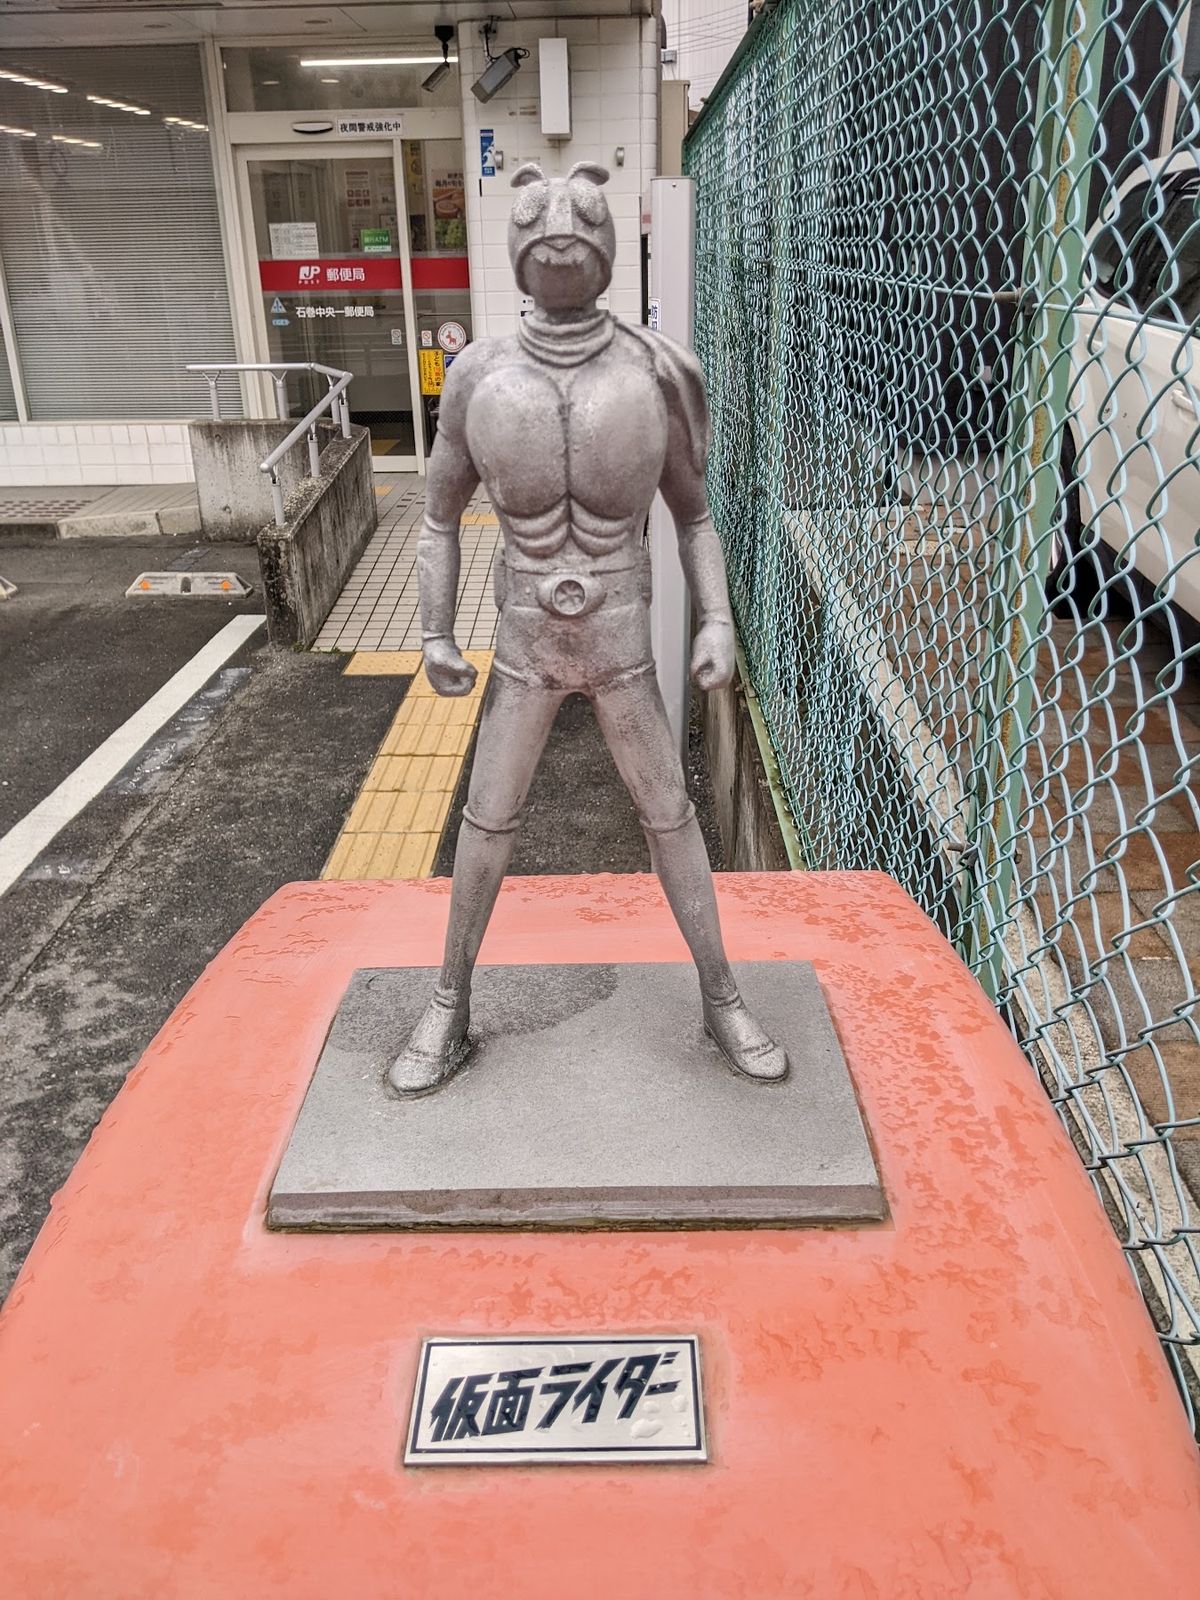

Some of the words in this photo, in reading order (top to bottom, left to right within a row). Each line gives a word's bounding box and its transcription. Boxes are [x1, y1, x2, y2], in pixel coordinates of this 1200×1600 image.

[340, 121, 401, 133] 夜間警戒強化中
[326, 267, 366, 282] 郵便局
[295, 306, 375, 318] 石巻中央一郵便局
[429, 1351, 681, 1442] 仮面ライダー
